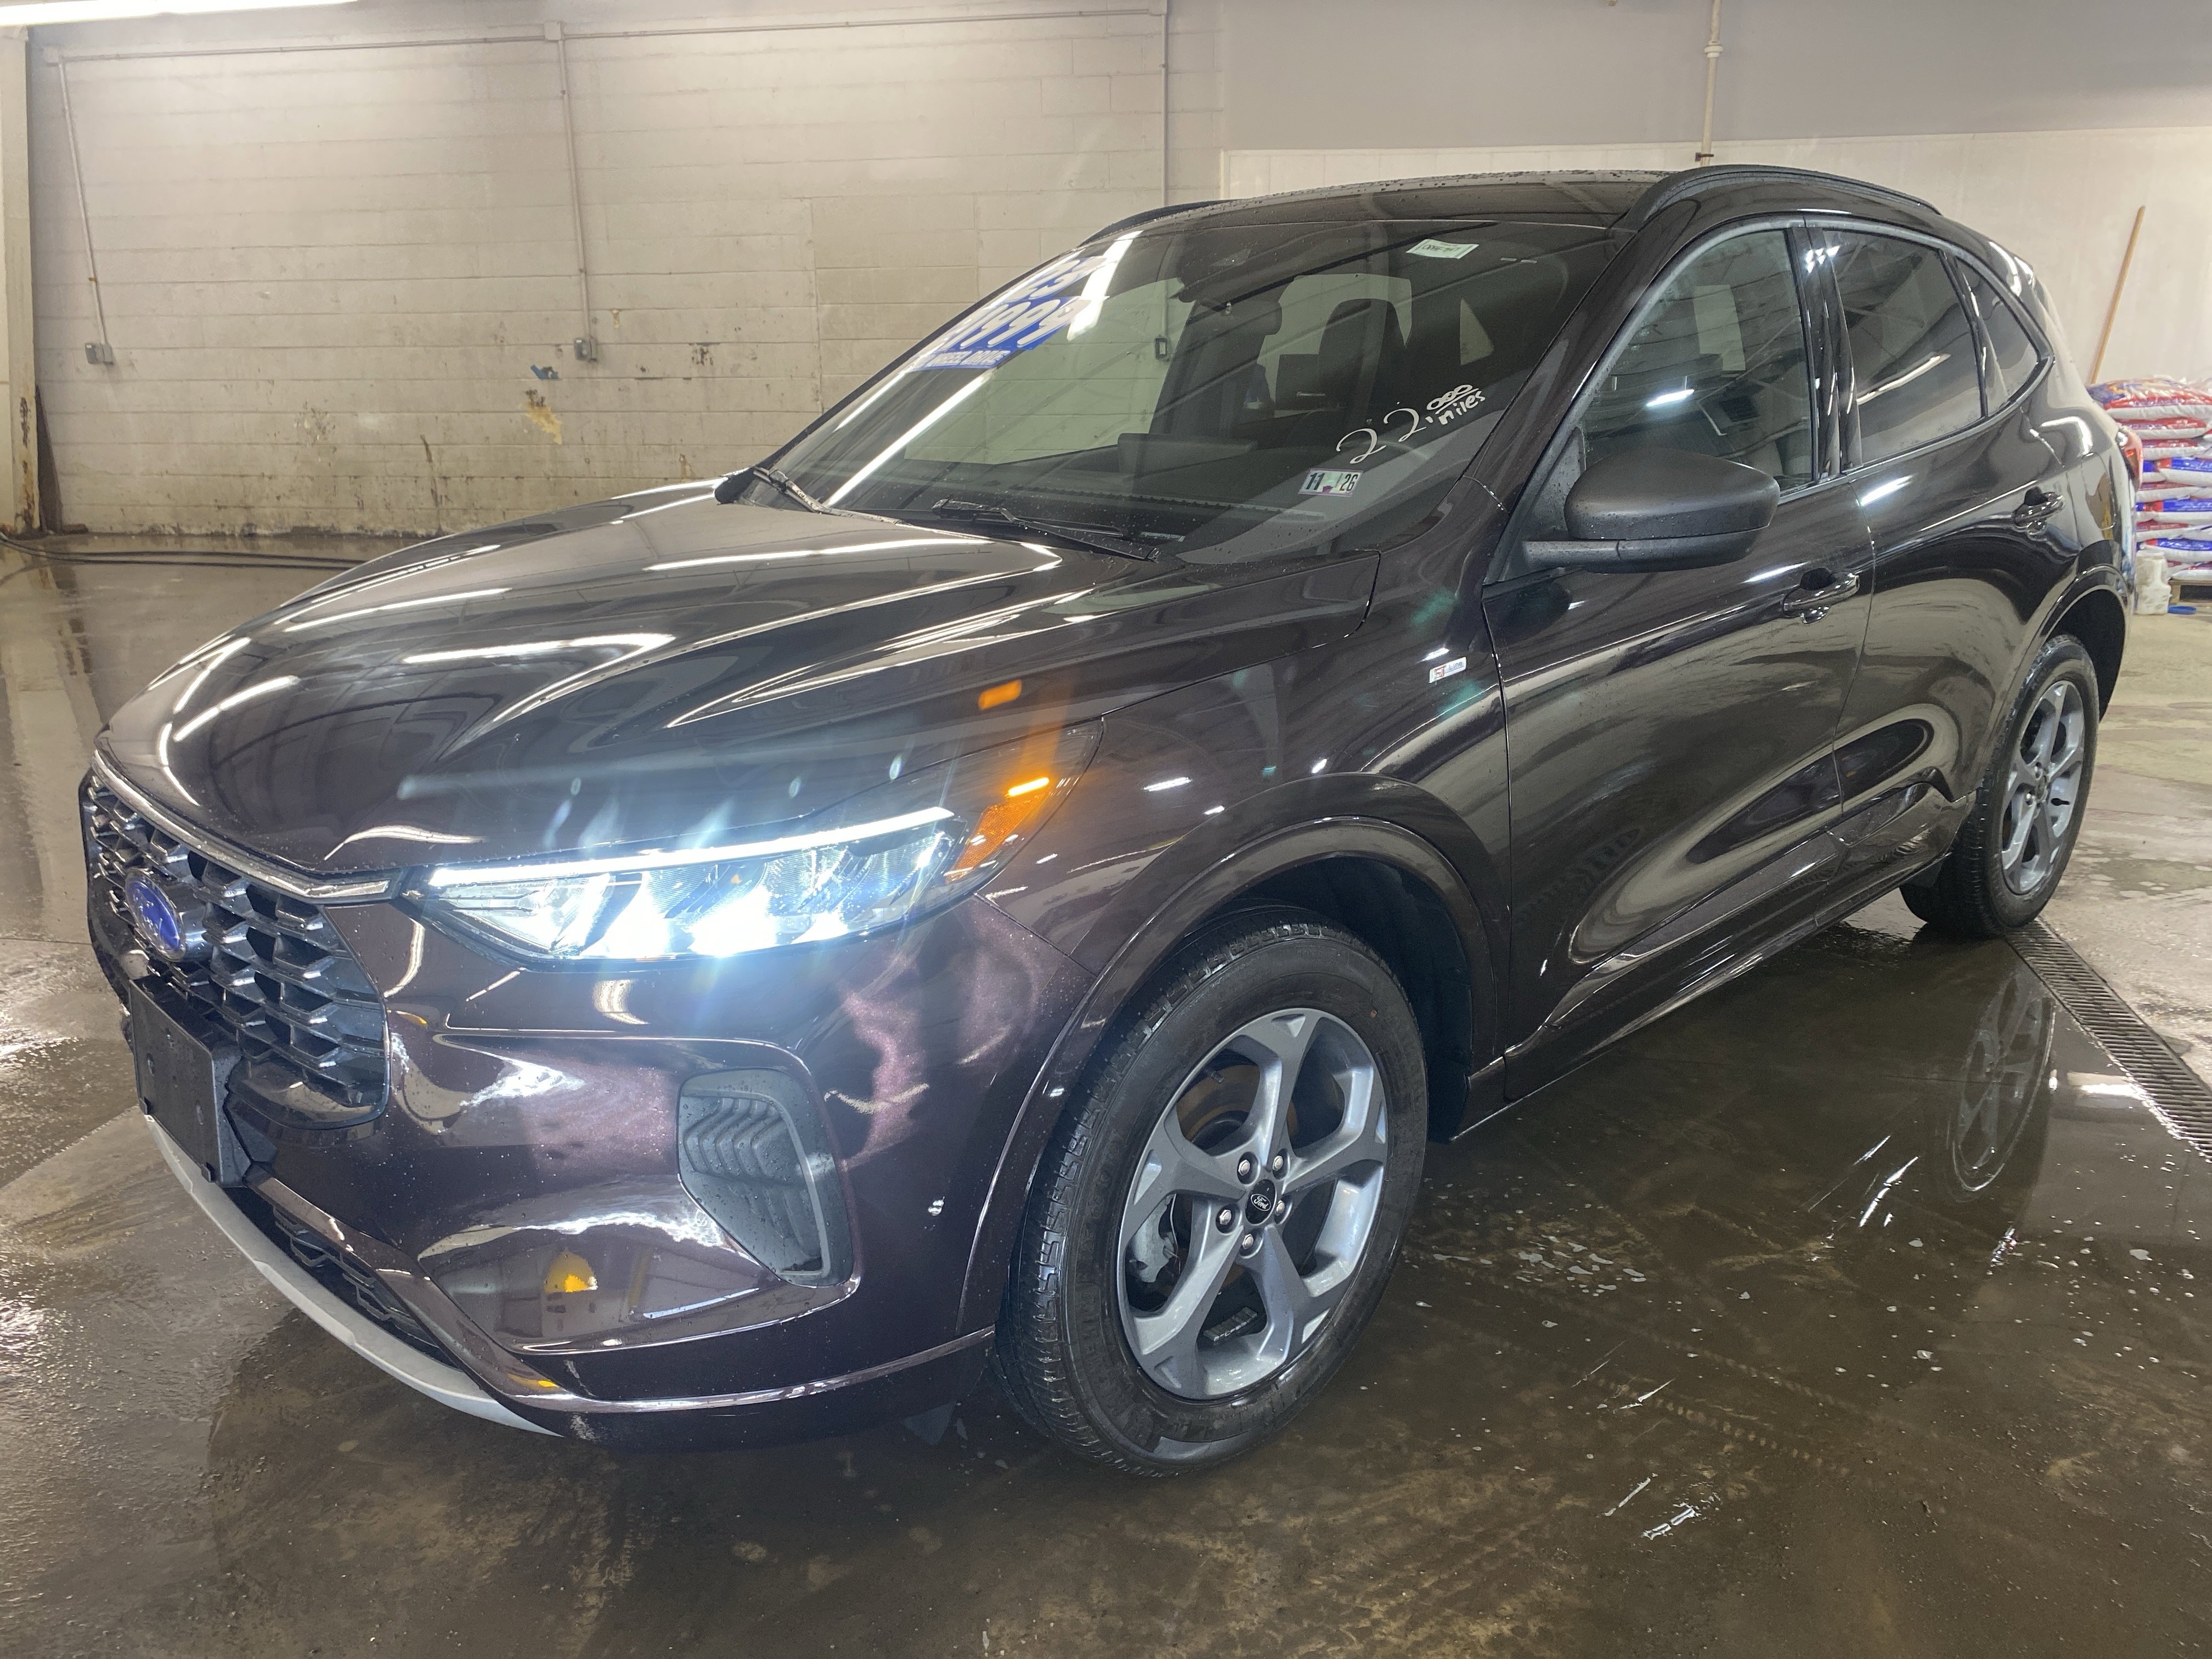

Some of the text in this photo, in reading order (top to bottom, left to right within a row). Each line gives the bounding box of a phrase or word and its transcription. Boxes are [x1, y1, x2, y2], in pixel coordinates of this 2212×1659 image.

[960, 350, 1011, 366] DRIVE
[1438, 391, 1486, 426] miles
[1305, 472, 1359, 492] 11 26
[1253, 1195, 1269, 1210] Ford
